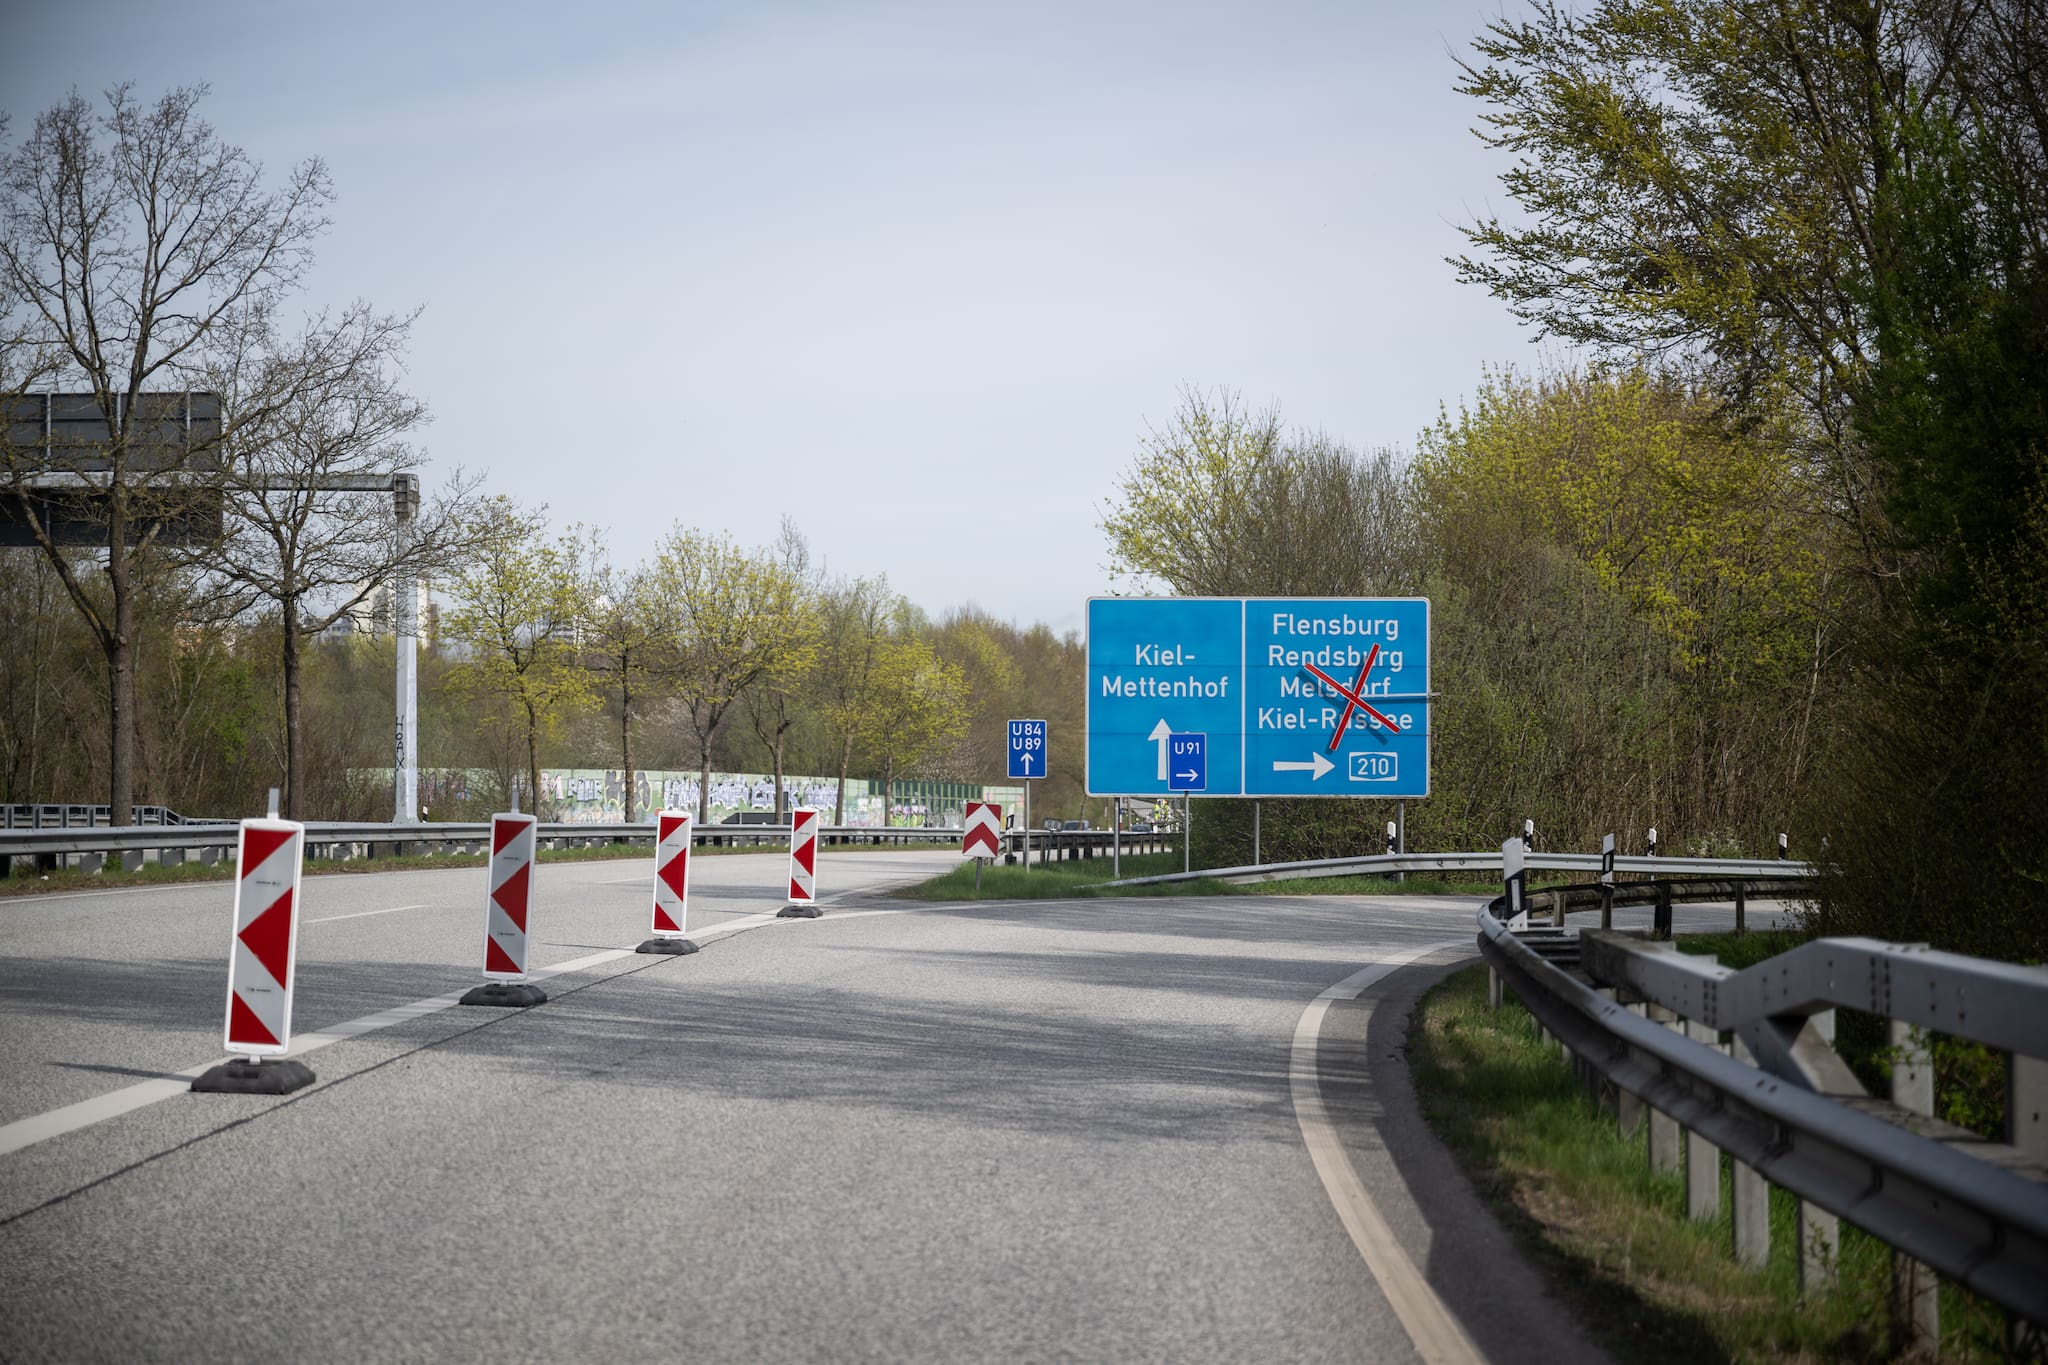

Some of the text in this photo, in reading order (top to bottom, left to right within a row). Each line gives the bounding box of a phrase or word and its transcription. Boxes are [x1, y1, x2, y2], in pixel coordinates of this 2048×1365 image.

[1273, 613, 1399, 641] Flensburg
[1135, 644, 1195, 666] Kiel-
[1102, 675, 1229, 698] Mettenhof
[1357, 758, 1390, 775] 210
